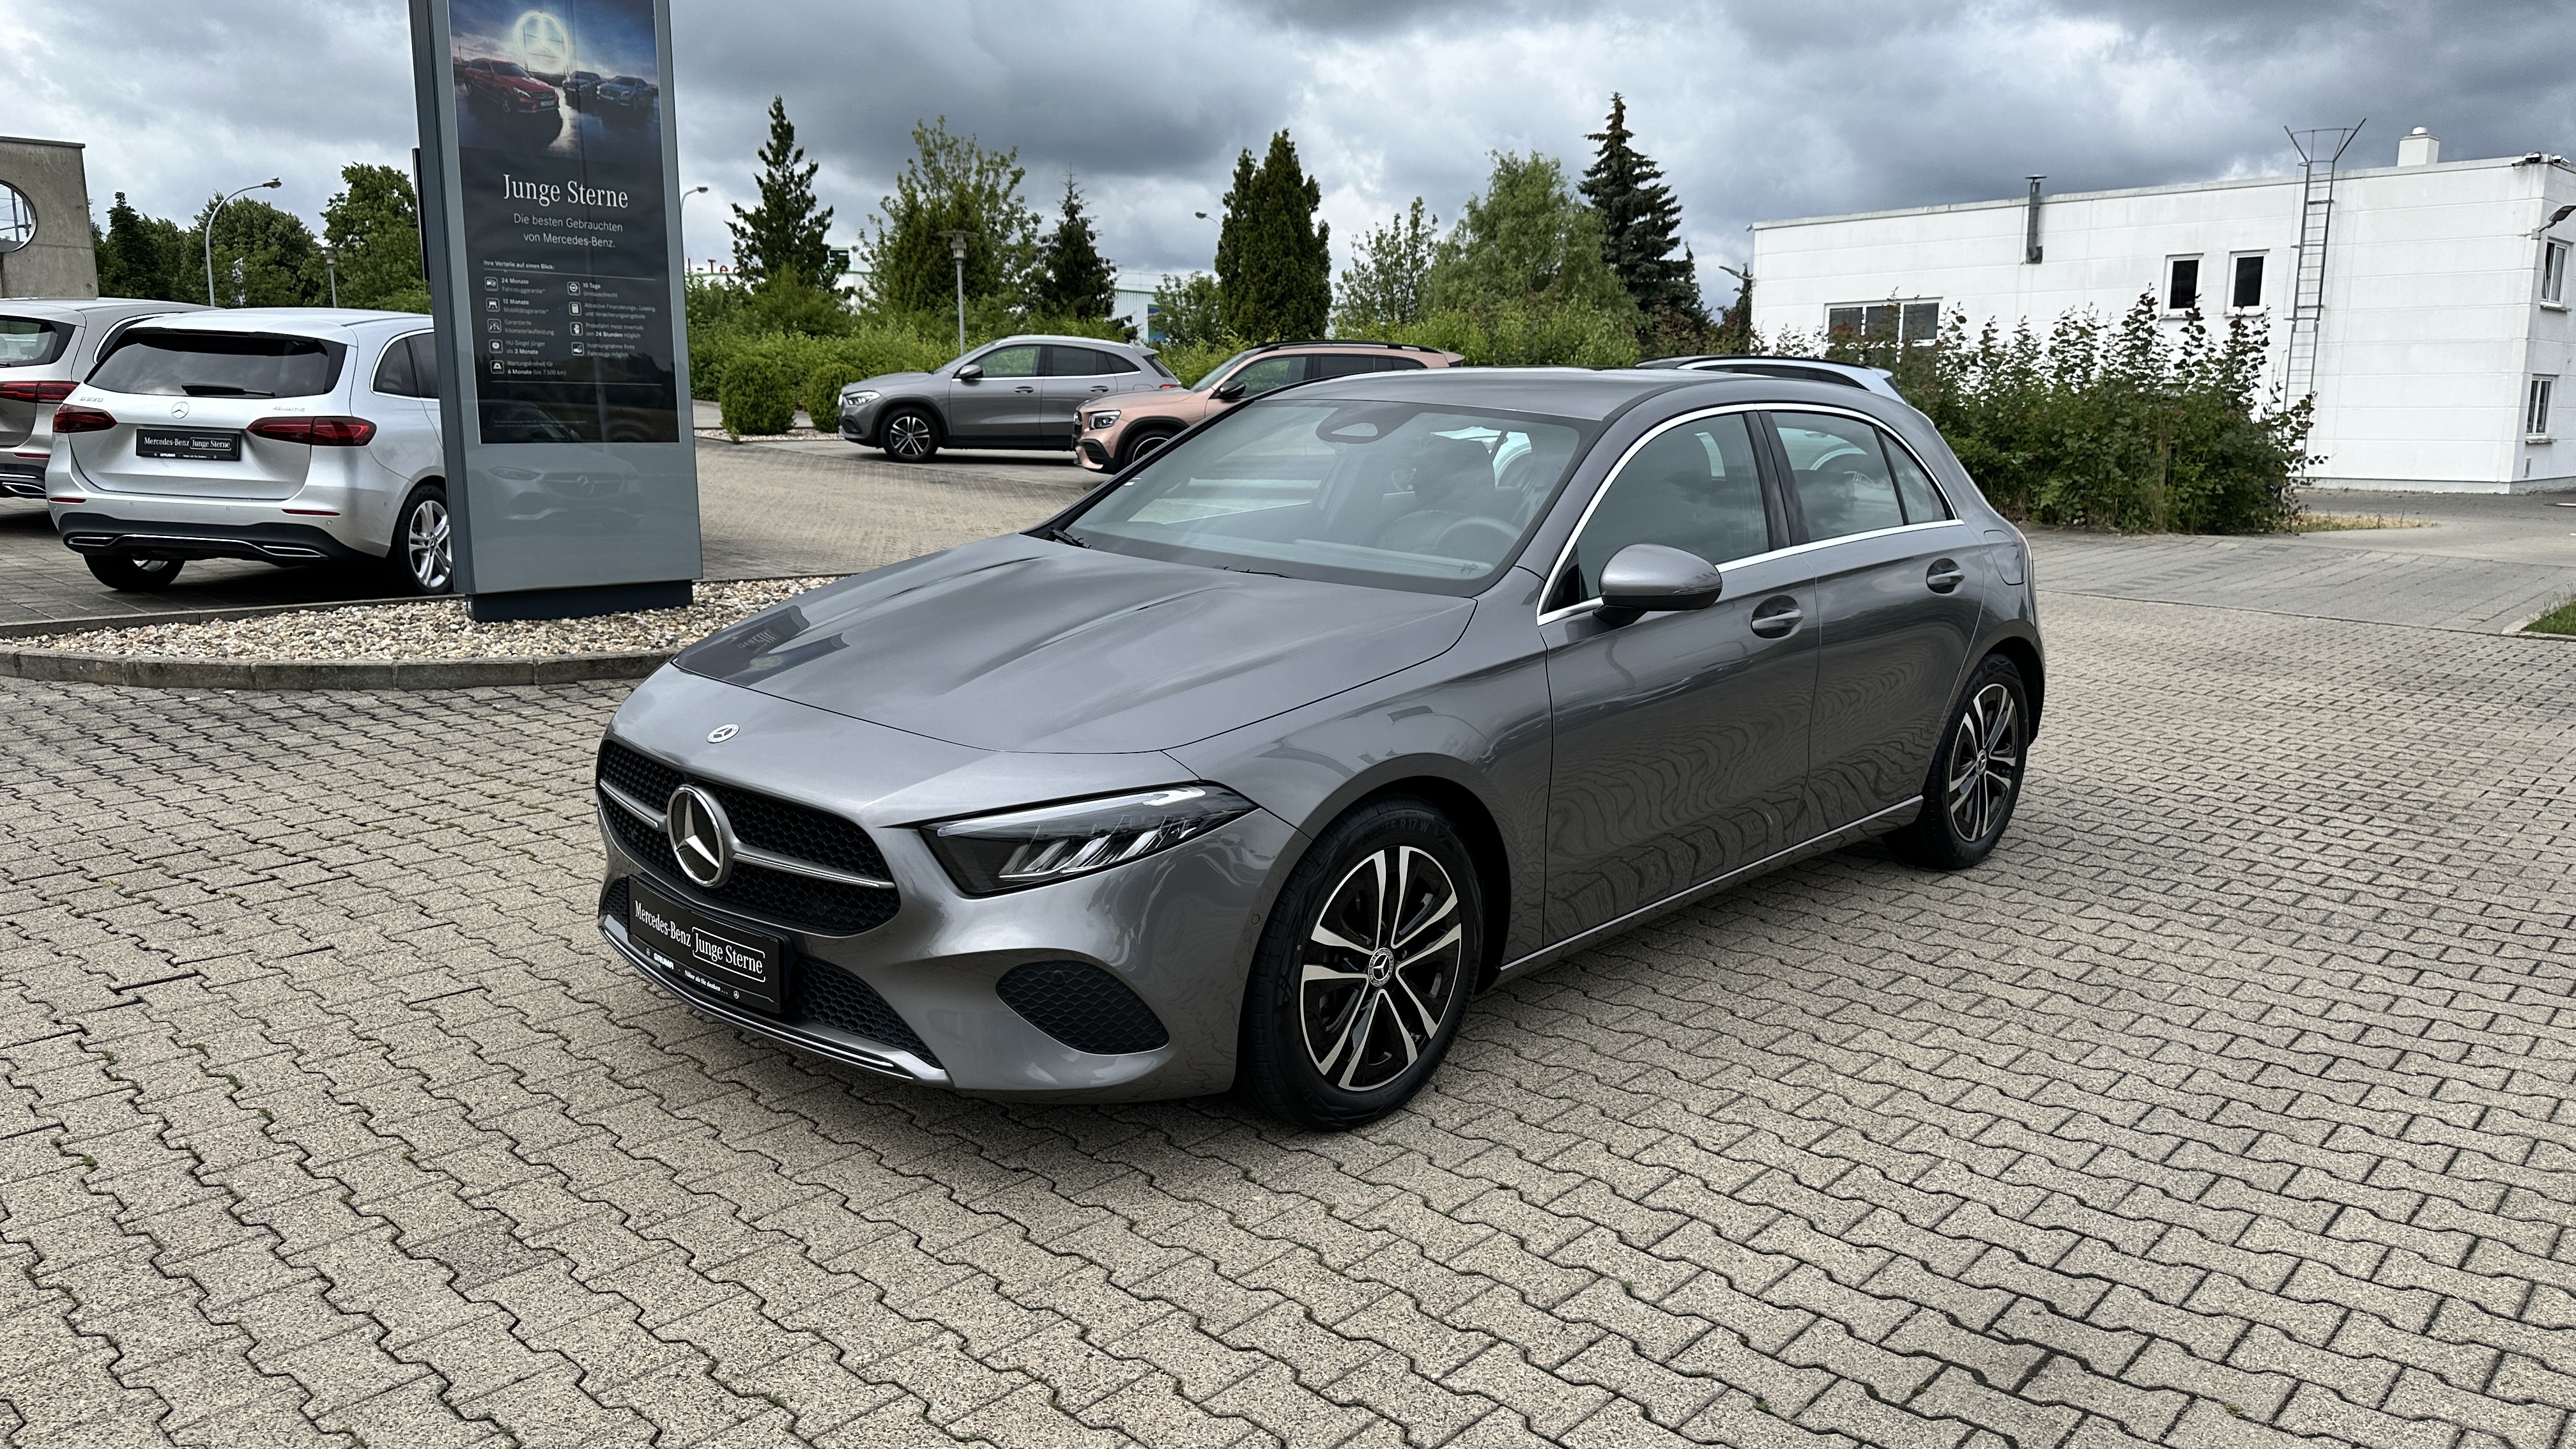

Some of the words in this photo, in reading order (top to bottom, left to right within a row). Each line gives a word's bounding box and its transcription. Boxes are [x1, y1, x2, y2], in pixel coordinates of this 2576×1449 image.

[503, 174, 560, 206] Junge
[567, 180, 628, 208] Sterne
[514, 213, 530, 224] Die
[532, 215, 564, 227] besten
[566, 218, 623, 232] Gebrauchten
[523, 233, 540, 241] von
[543, 233, 616, 248] Mercedes-Benz.
[144, 436, 190, 447] Mercedes-Benz
[192, 439, 209, 448] Junge
[210, 440, 231, 448] Sterne
[634, 900, 691, 947] Mercedes-Benz
[694, 933, 723, 962] Junge
[726, 945, 763, 974] Sterne
